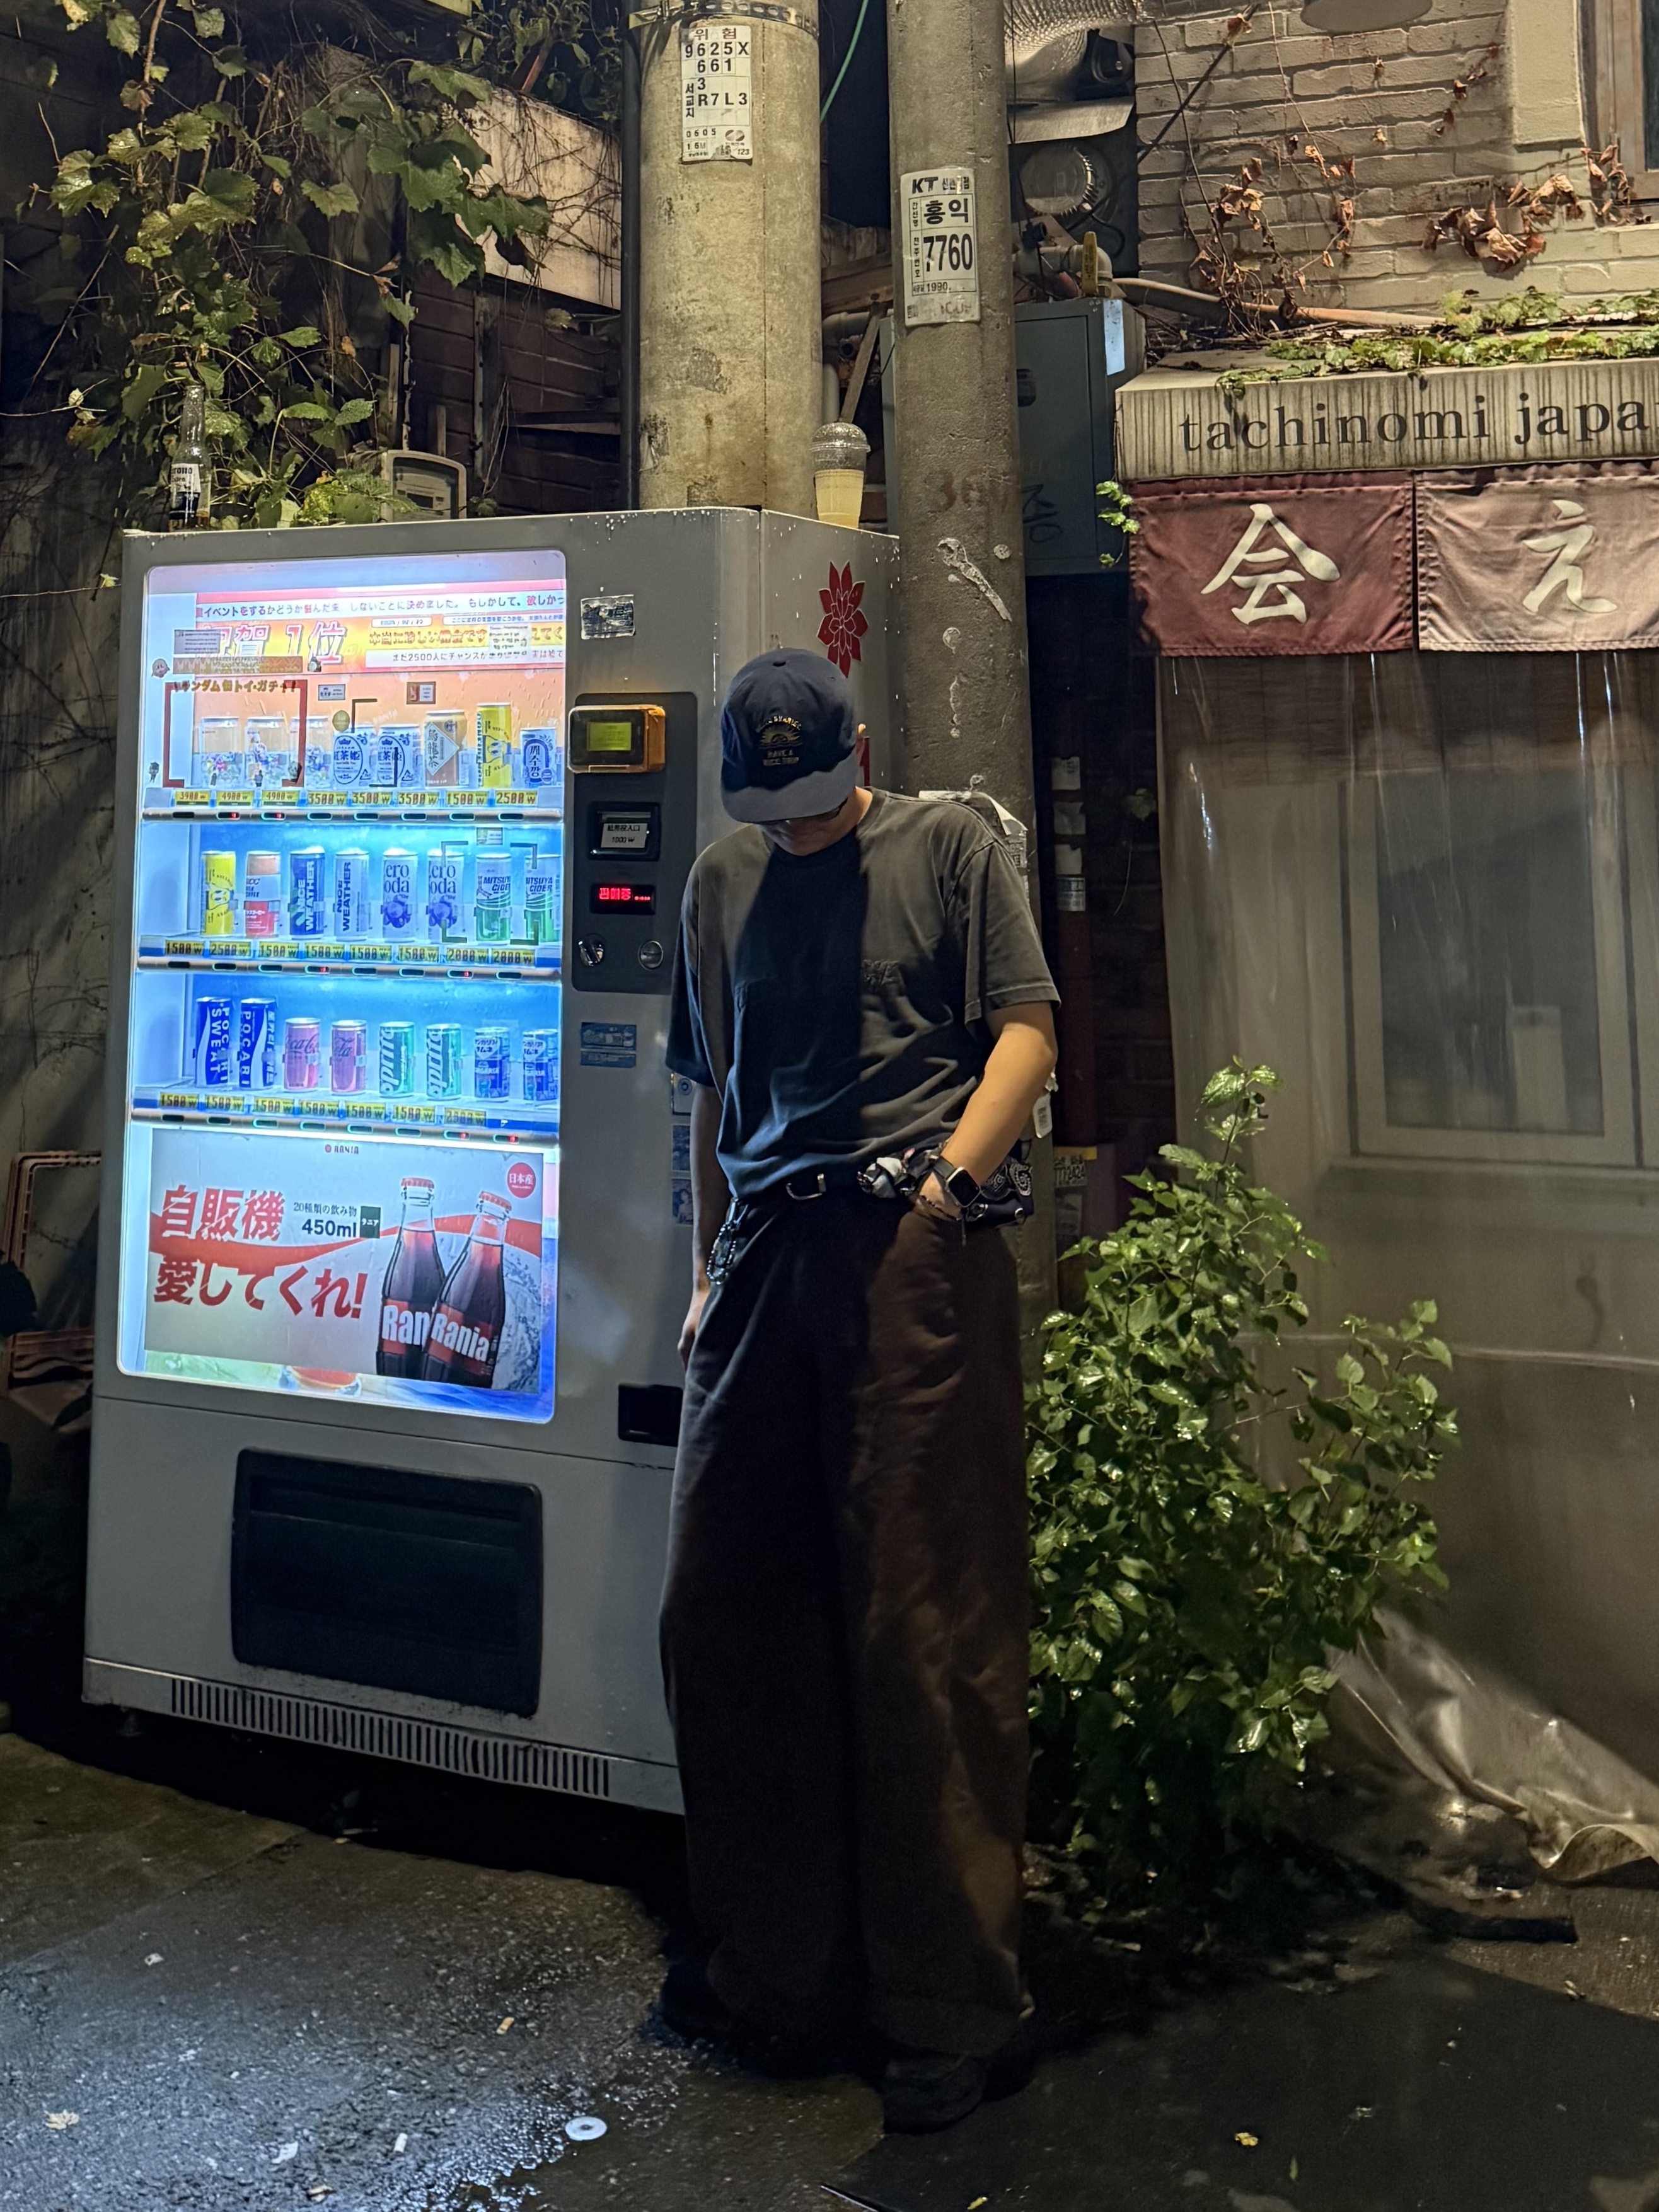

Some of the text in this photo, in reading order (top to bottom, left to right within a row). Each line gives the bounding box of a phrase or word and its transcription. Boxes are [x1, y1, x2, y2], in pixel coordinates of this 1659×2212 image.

[685, 42, 749, 58] 9625X
[697, 58, 732, 73] 661
[697, 78, 706, 90] 3
[686, 128, 716, 138] 0605
[911, 176, 939, 194] KT
[923, 198, 969, 224] 홍익
[923, 233, 973, 272] 7760
[1180, 391, 1659, 452] tachinomi japa
[1201, 504, 1340, 626] 会
[1523, 499, 1618, 614] え
[306, 861, 315, 931] WEATHER
[343, 861, 351, 932] WEATHER
[210, 1008, 223, 1073] SWEAT
[241, 1011, 251, 1085] POCARI
[161, 1184, 286, 1242] 自販機
[293, 1202, 357, 1217] 20種類の飲み物
[301, 1218, 357, 1238] 450ml
[154, 1257, 369, 1320] 愛してくれ!
[431, 1313, 490, 1362] Rania
